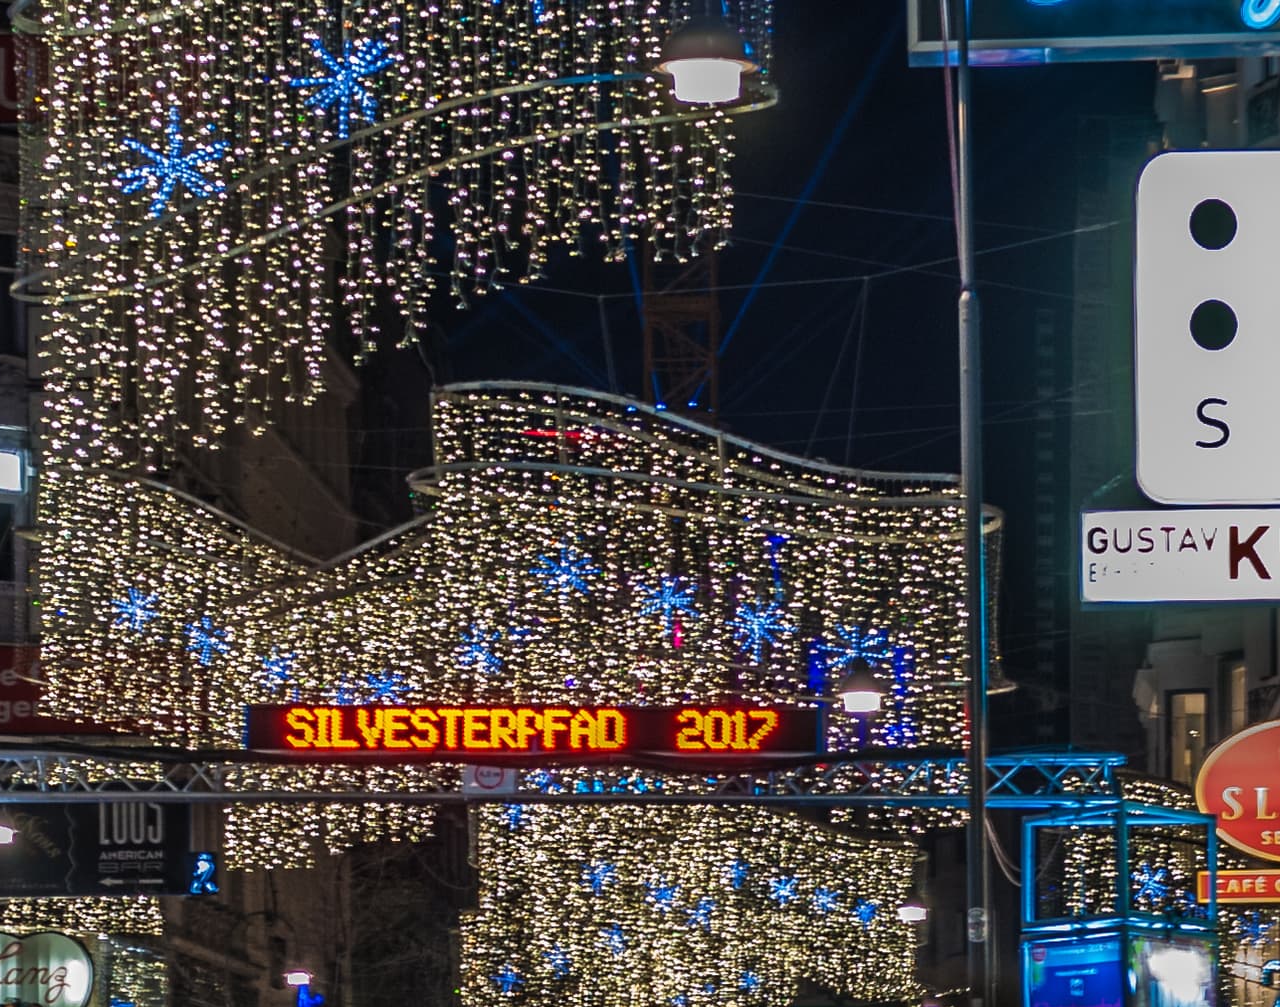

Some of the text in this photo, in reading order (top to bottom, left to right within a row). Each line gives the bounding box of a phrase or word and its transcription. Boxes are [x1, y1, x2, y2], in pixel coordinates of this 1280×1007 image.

[1087, 526, 1218, 554] GUSTAV
[285, 708, 779, 751] SILVESTERPFAD 2017
[99, 850, 164, 861] AMERICAN
